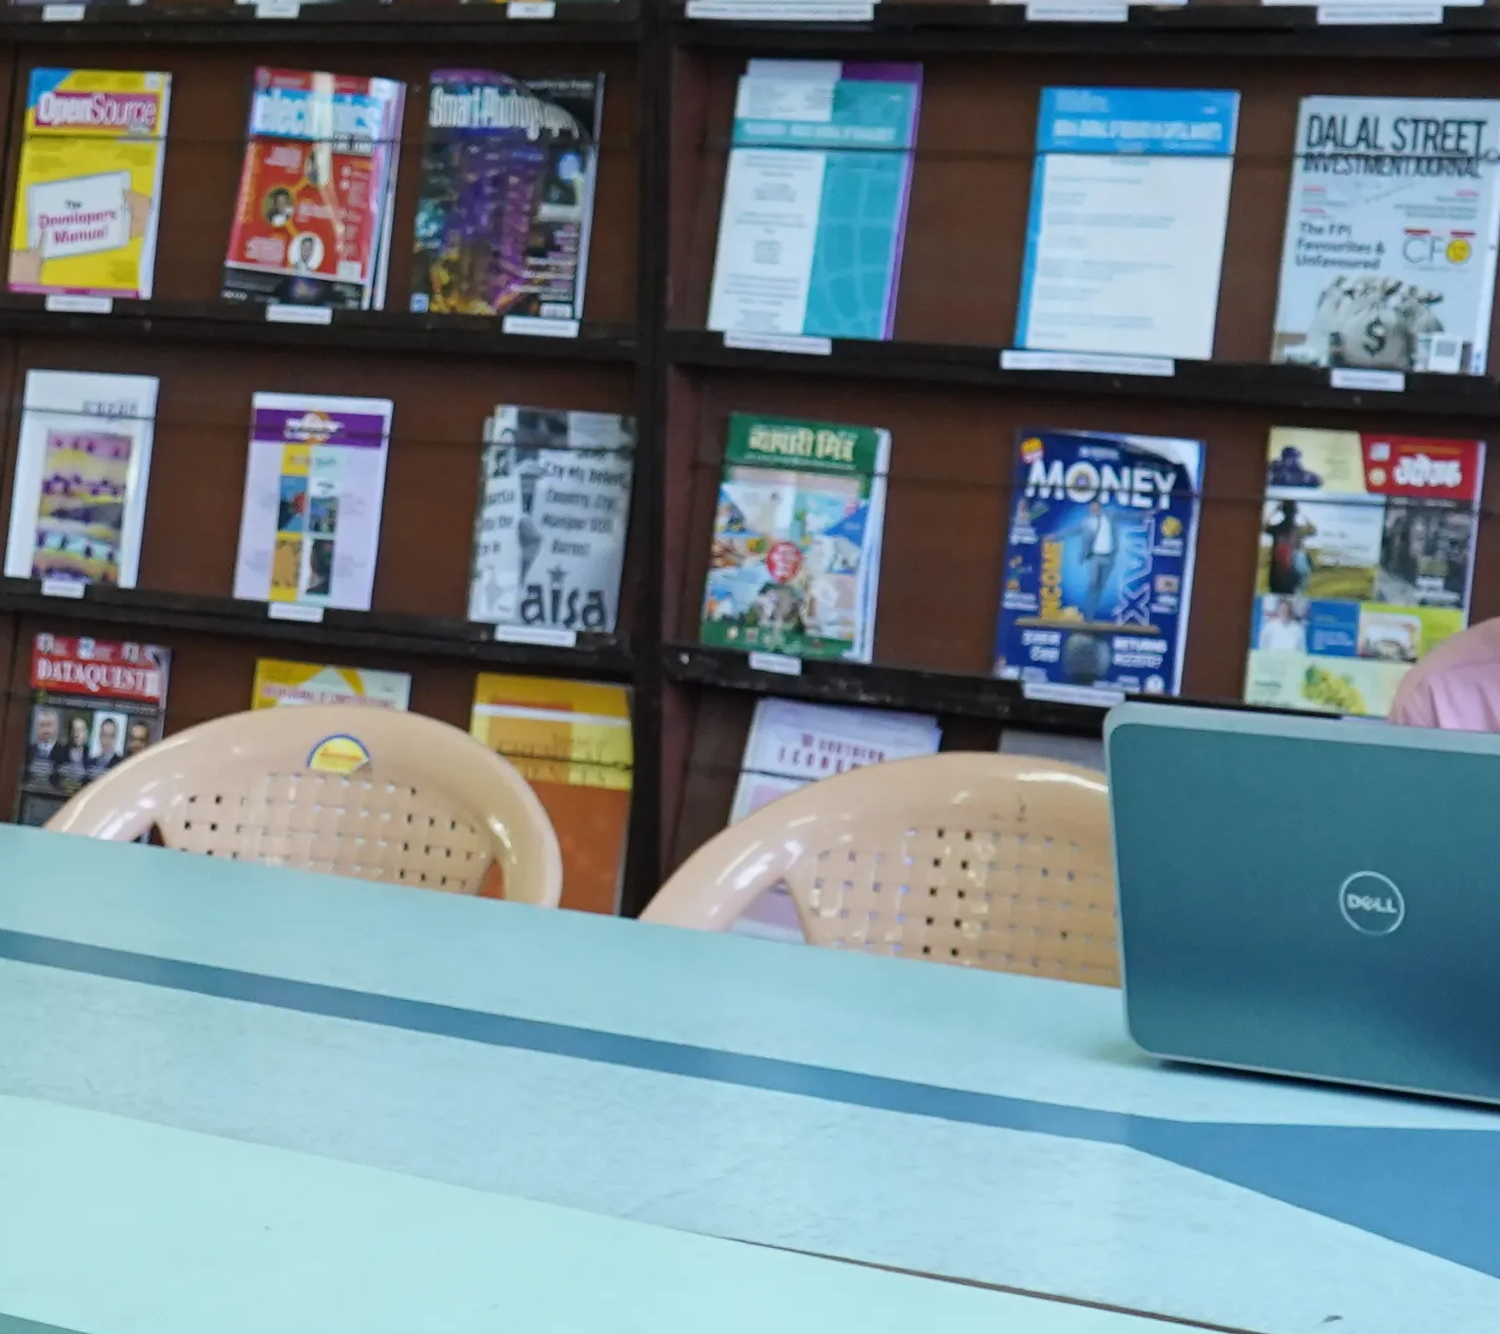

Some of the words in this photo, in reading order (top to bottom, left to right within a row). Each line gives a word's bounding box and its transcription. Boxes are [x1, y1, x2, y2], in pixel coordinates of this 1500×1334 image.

[1306, 115, 1383, 149] DALAL
[1391, 118, 1488, 157] STREET
[1024, 458, 1177, 509] MONEY
[521, 585, 608, 628] aisa
[1346, 893, 1399, 914] DELL
